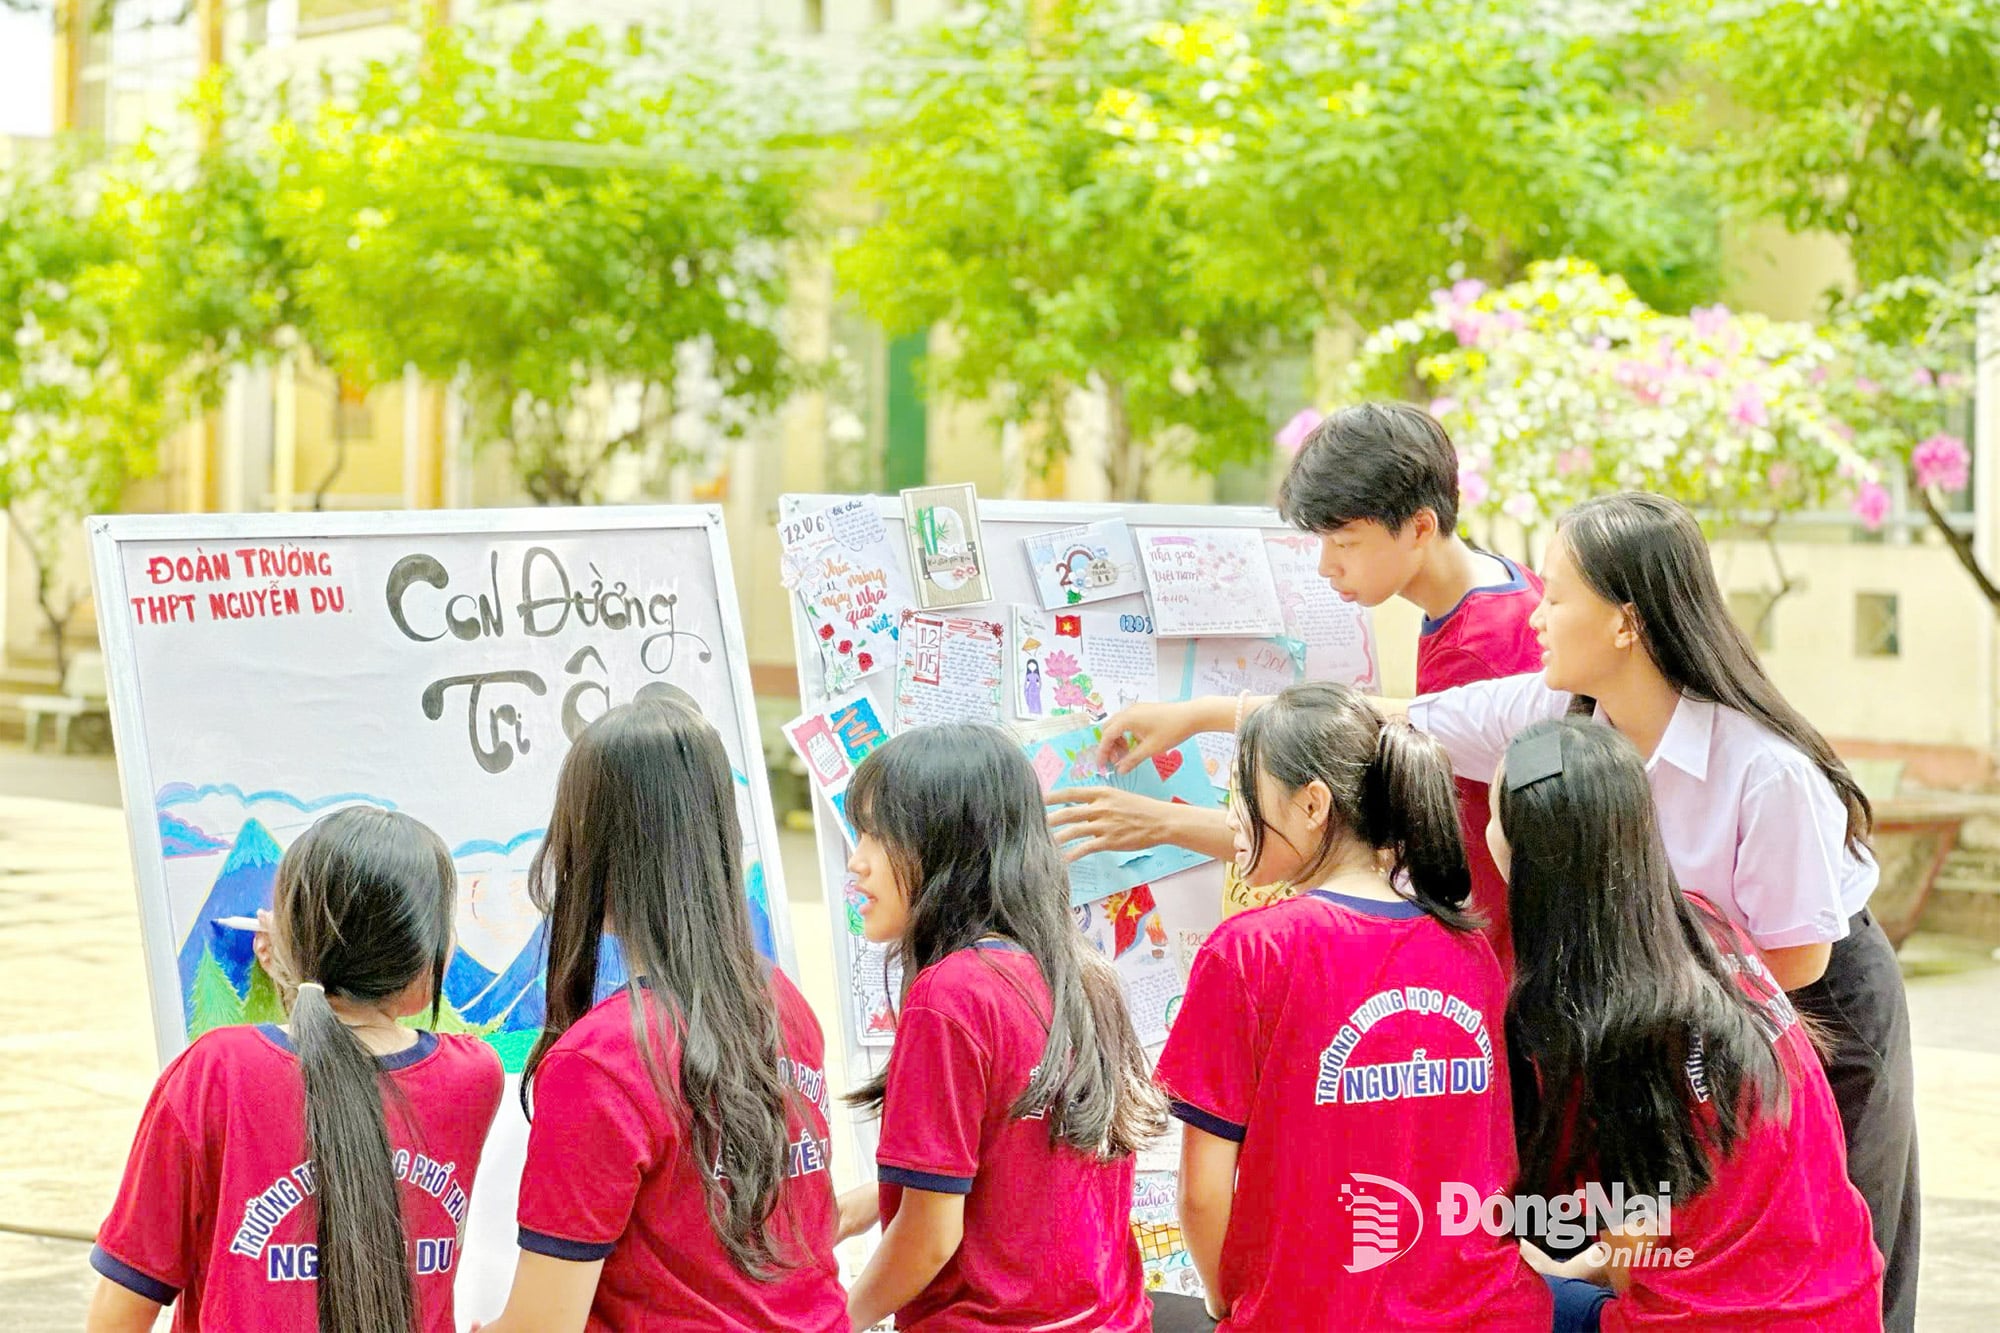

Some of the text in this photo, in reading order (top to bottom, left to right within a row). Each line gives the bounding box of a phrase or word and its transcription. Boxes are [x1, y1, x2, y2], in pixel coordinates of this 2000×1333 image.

[146, 542, 333, 584] ĐOÀN TRƯỜNG
[131, 594, 196, 625] THPT
[208, 580, 300, 620] NGUYỄN
[421, 669, 547, 774] Tri
[1315, 1024, 1362, 1105] TRƯỜNG
[1350, 988, 1408, 1034] TRUNG
[1405, 986, 1443, 1015] HỌC
[1343, 1049, 1489, 1104] NGUYỄN DU
[409, 1154, 456, 1198] PHỔ
[230, 1176, 304, 1260] TRƯỜNG
[416, 1238, 455, 1275] DU
